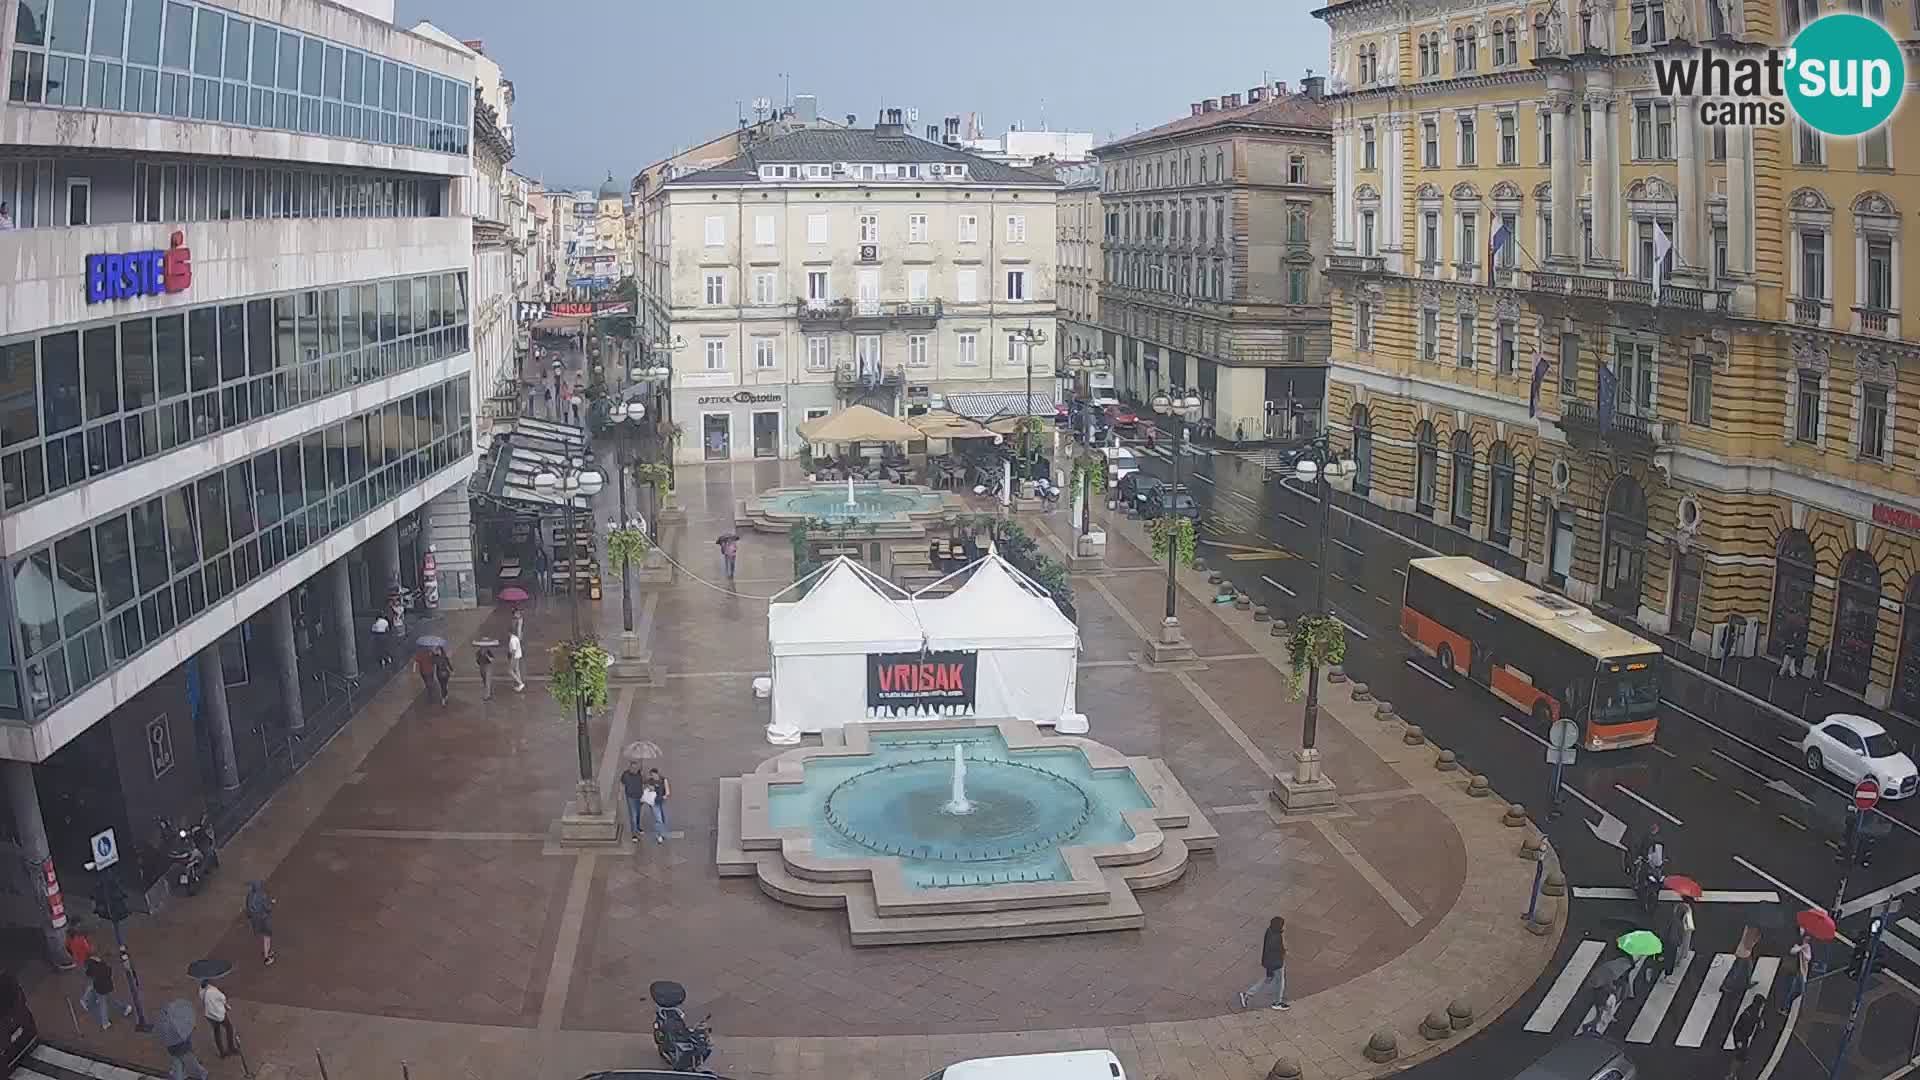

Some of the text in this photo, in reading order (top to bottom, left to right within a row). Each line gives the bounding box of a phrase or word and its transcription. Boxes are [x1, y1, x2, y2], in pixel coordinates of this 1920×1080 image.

[86, 251, 166, 304] ERSTE
[698, 396, 731, 404] OPTIKA
[879, 663, 963, 691] VRISAK
